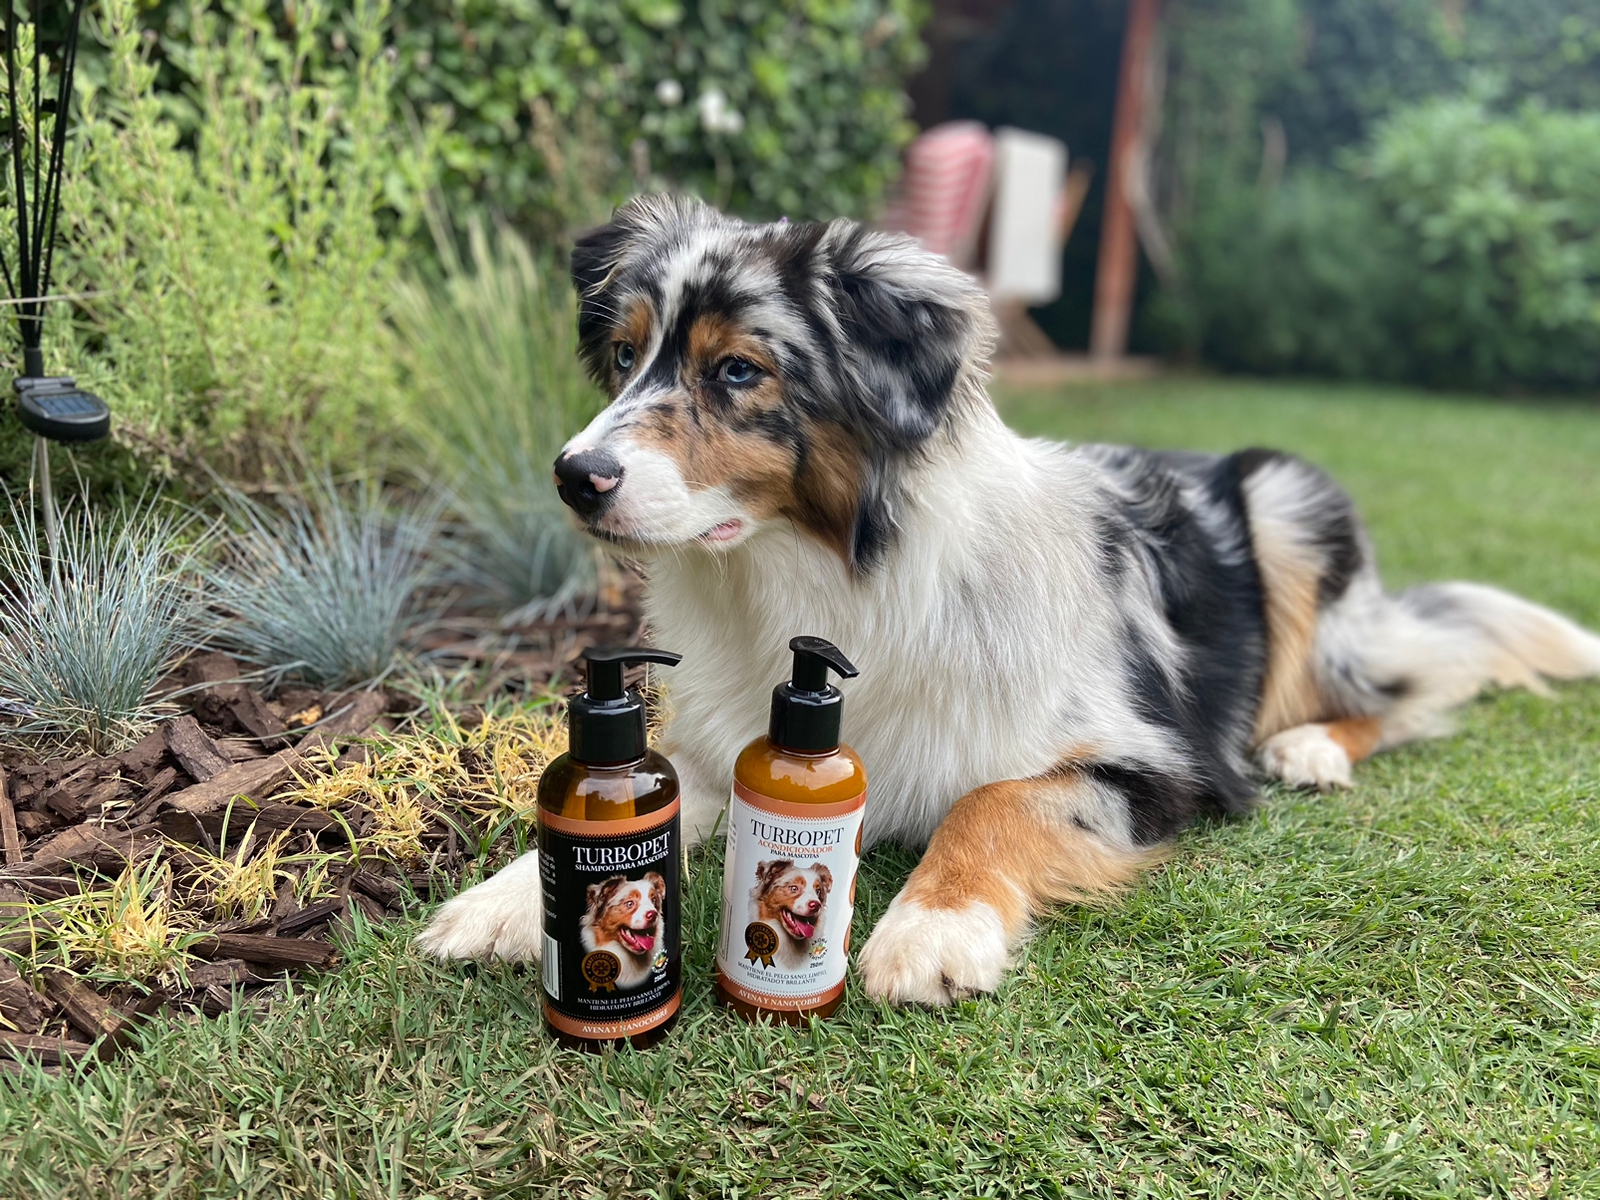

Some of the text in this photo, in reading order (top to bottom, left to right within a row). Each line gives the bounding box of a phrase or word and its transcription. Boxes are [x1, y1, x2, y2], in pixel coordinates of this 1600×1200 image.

[751, 818, 844, 846] TURBOPET
[572, 831, 670, 865] TURBOPET
[758, 839, 833, 853] ACONDICIONADOR
[770, 849, 786, 857] PARA
[575, 849, 669, 872] SHAMPOO PARA MASCOTAS
[737, 961, 765, 977] MANTIENE
[738, 989, 762, 1003] AVENA
[770, 996, 822, 1007] NANOCOBRE
[582, 1008, 669, 1034] AVENA Y NANOCOBRE
